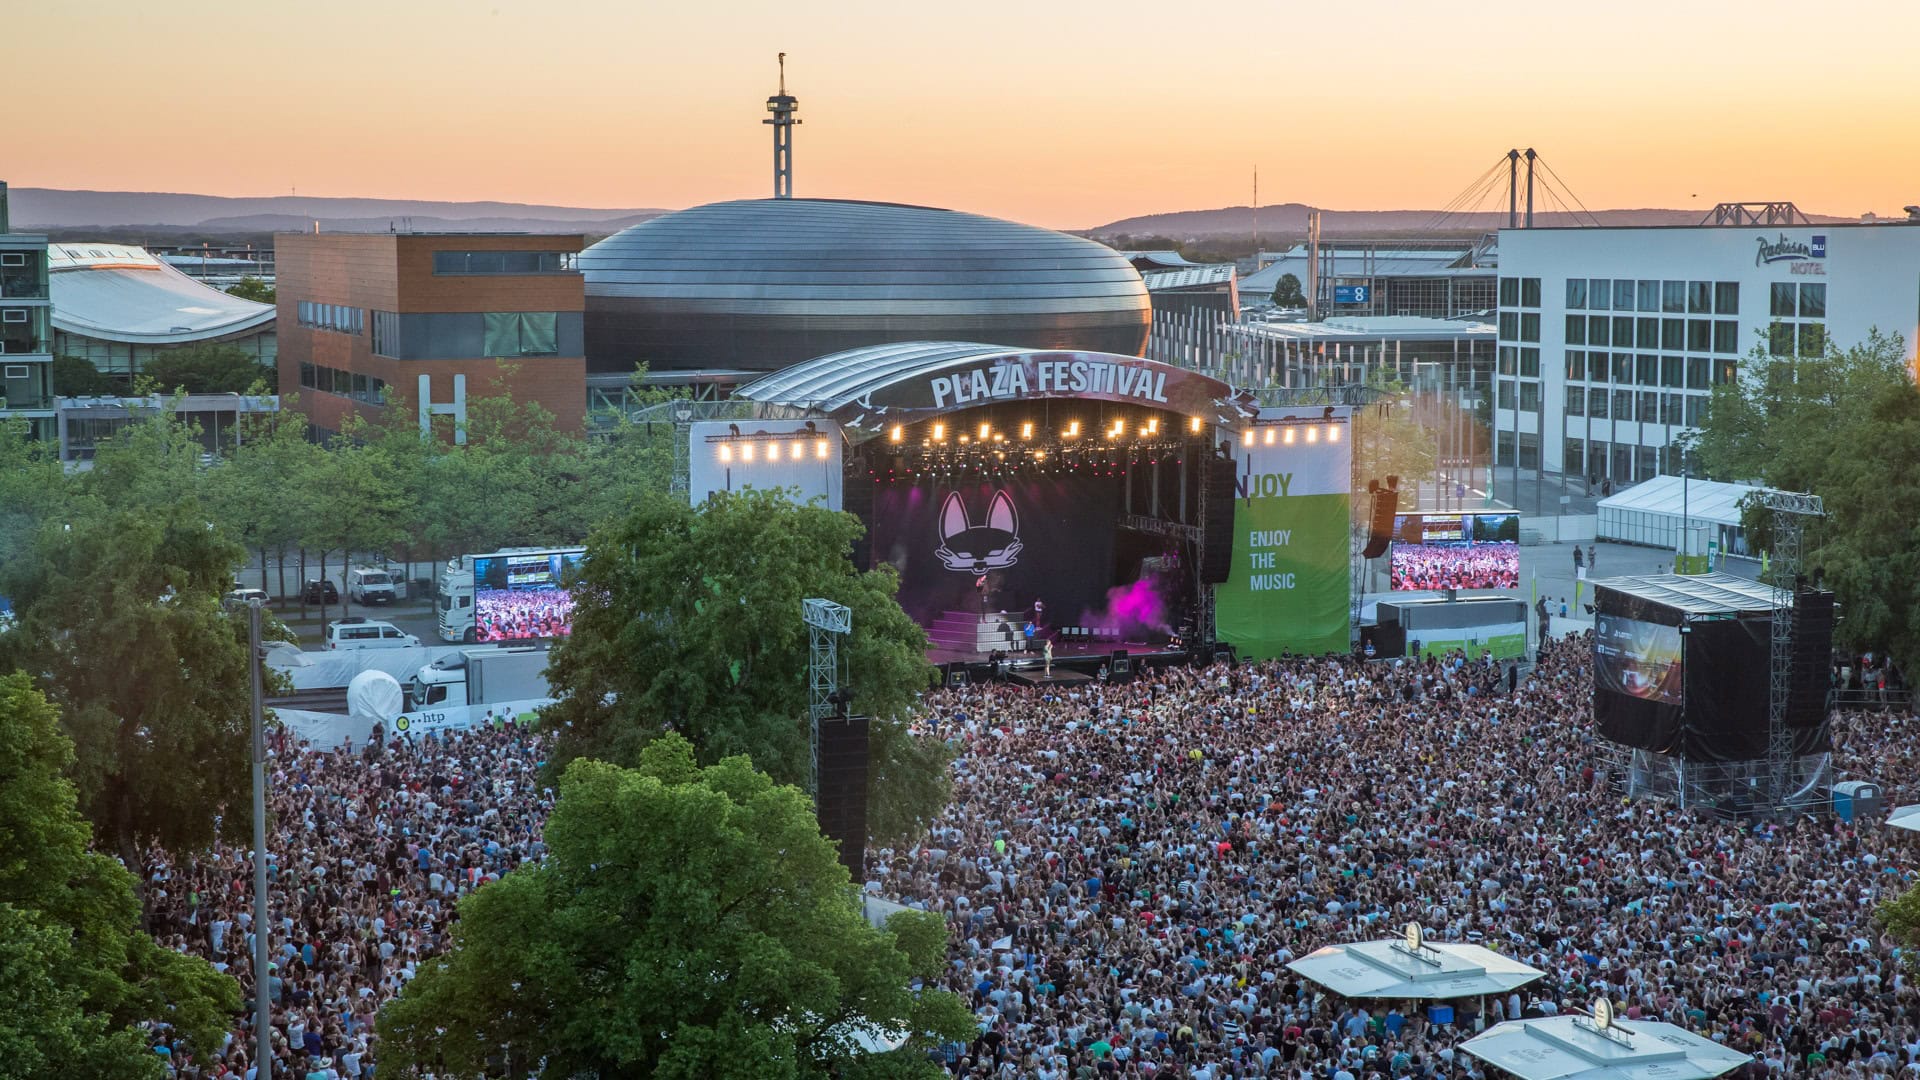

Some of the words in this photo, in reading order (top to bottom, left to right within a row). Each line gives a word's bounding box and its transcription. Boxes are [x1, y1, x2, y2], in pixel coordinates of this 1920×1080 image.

[1756, 232, 1811, 268] Radisson
[1790, 262, 1826, 275] HOTEL
[1354, 287, 1364, 301] 8
[931, 363, 1029, 408] PLAZA
[1038, 361, 1168, 403] FESTIVAL
[418, 374, 466, 446] H
[1250, 530, 1291, 547] ENJOY
[1250, 552, 1276, 569] THE
[1250, 573, 1296, 591] MUSIC
[422, 713, 445, 723] htp
